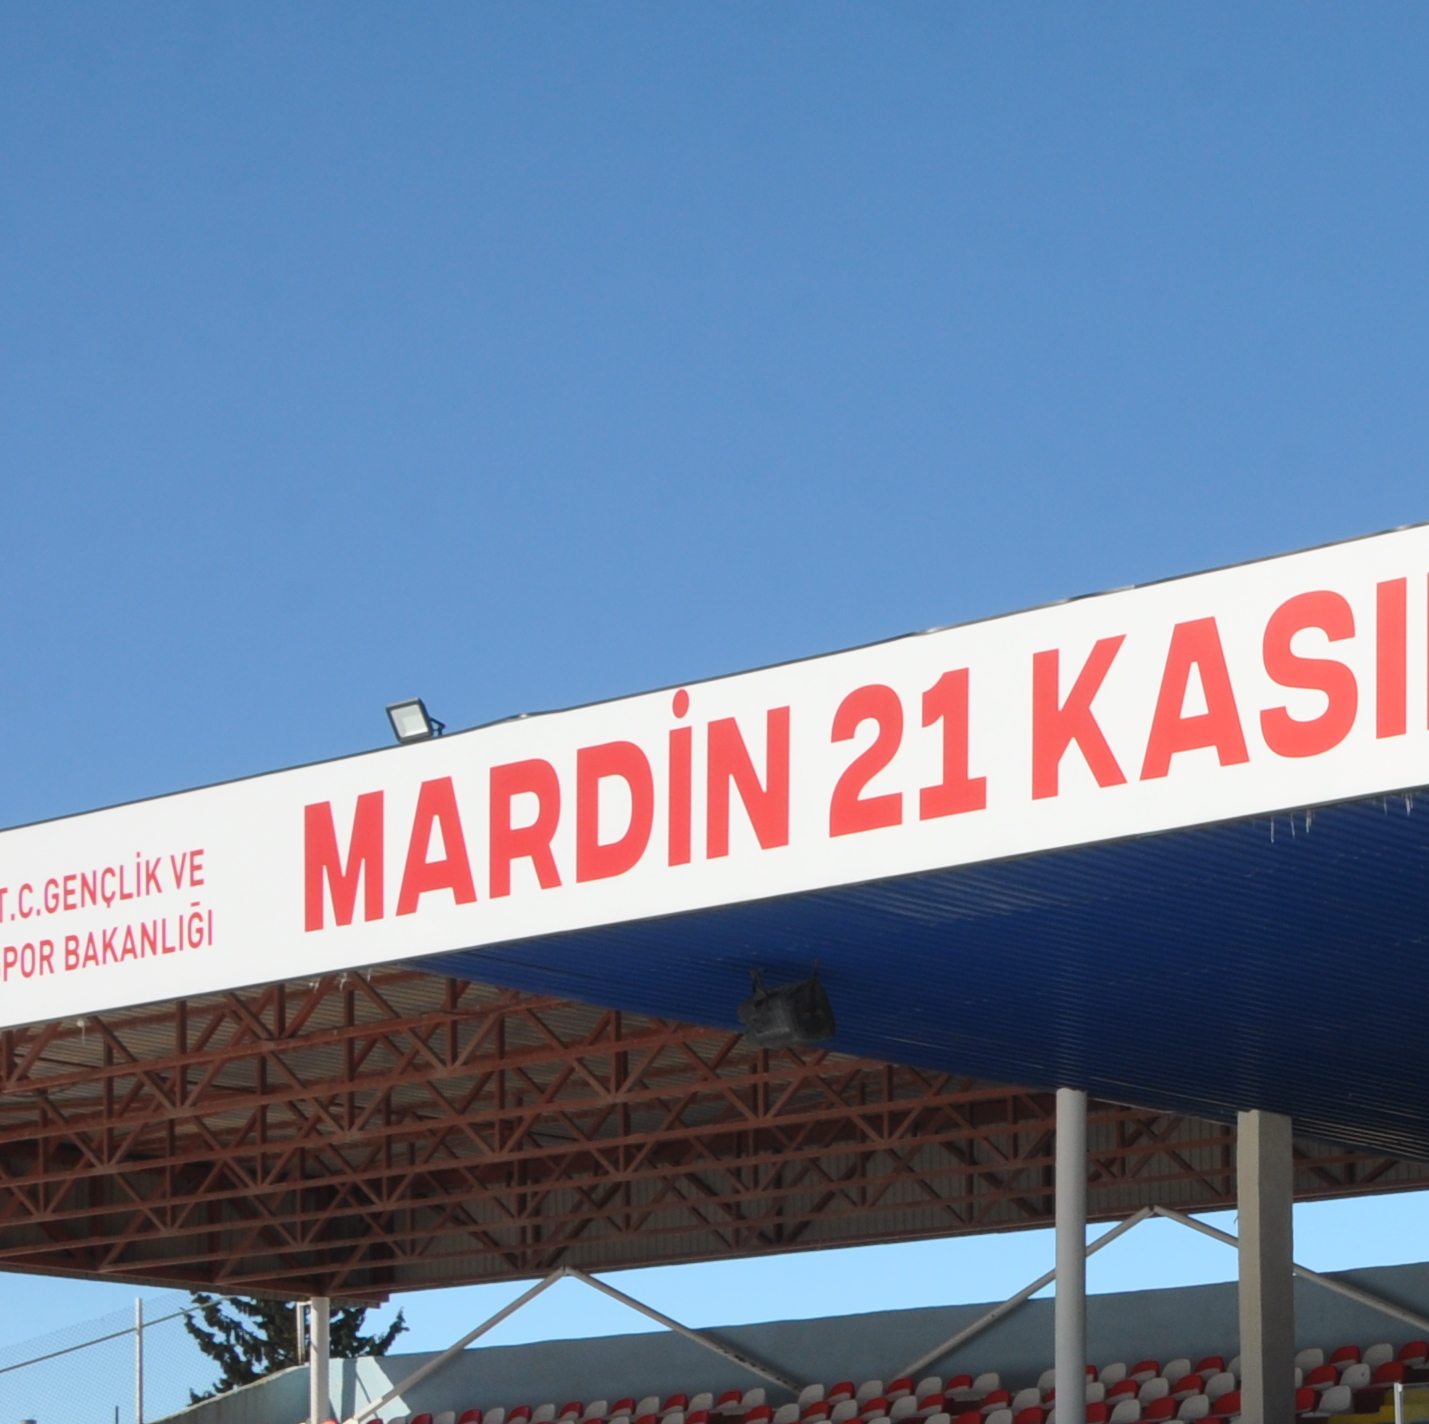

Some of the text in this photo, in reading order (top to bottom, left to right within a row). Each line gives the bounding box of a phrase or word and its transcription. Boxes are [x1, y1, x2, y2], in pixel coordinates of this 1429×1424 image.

[305, 668, 790, 932] MARDİN
[830, 668, 987, 838] 21
[170, 848, 204, 889] VE
[0, 901, 213, 982] POR BAKANLIĞI
